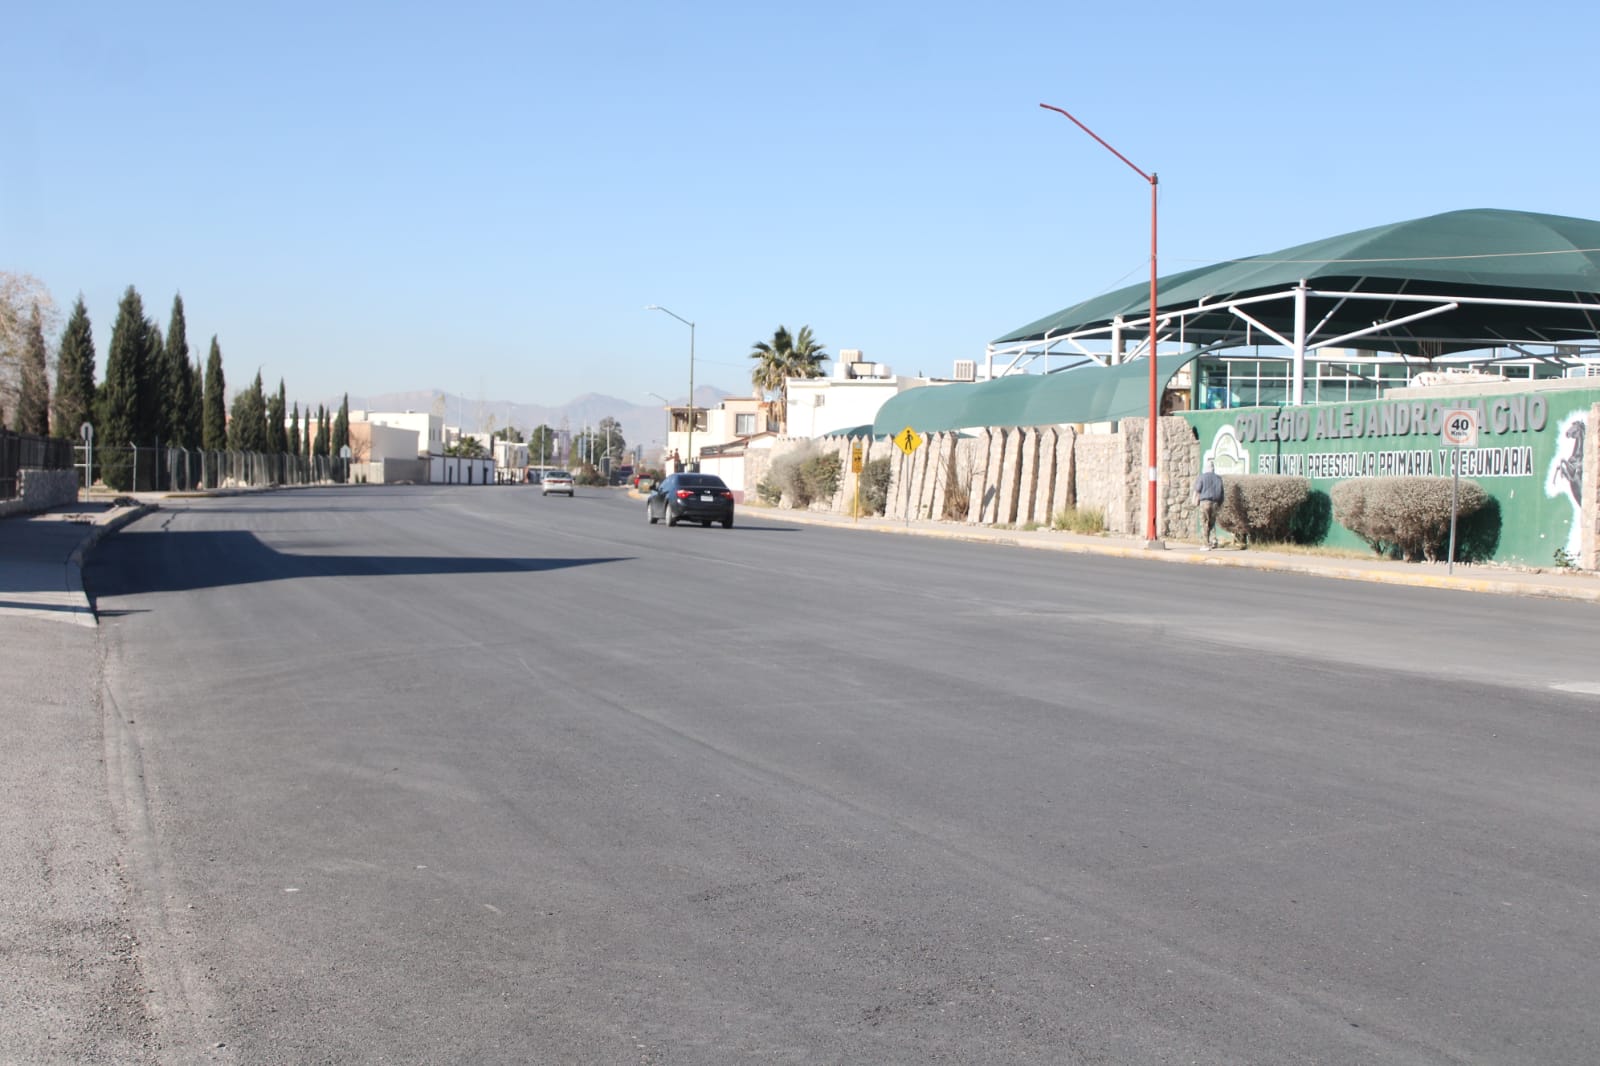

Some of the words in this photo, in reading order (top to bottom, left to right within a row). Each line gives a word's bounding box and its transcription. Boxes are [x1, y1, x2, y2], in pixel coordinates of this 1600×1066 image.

[1234, 410, 1310, 442] COLEGIO
[1316, 401, 1442, 440] ALEJANDRO
[1451, 418, 1469, 430] 40
[1258, 455, 1304, 476] ESTNCIA
[1308, 453, 1375, 477] PREESCOLAR
[1379, 451, 1433, 477] PRIMARIA
[1439, 451, 1447, 476] Y
